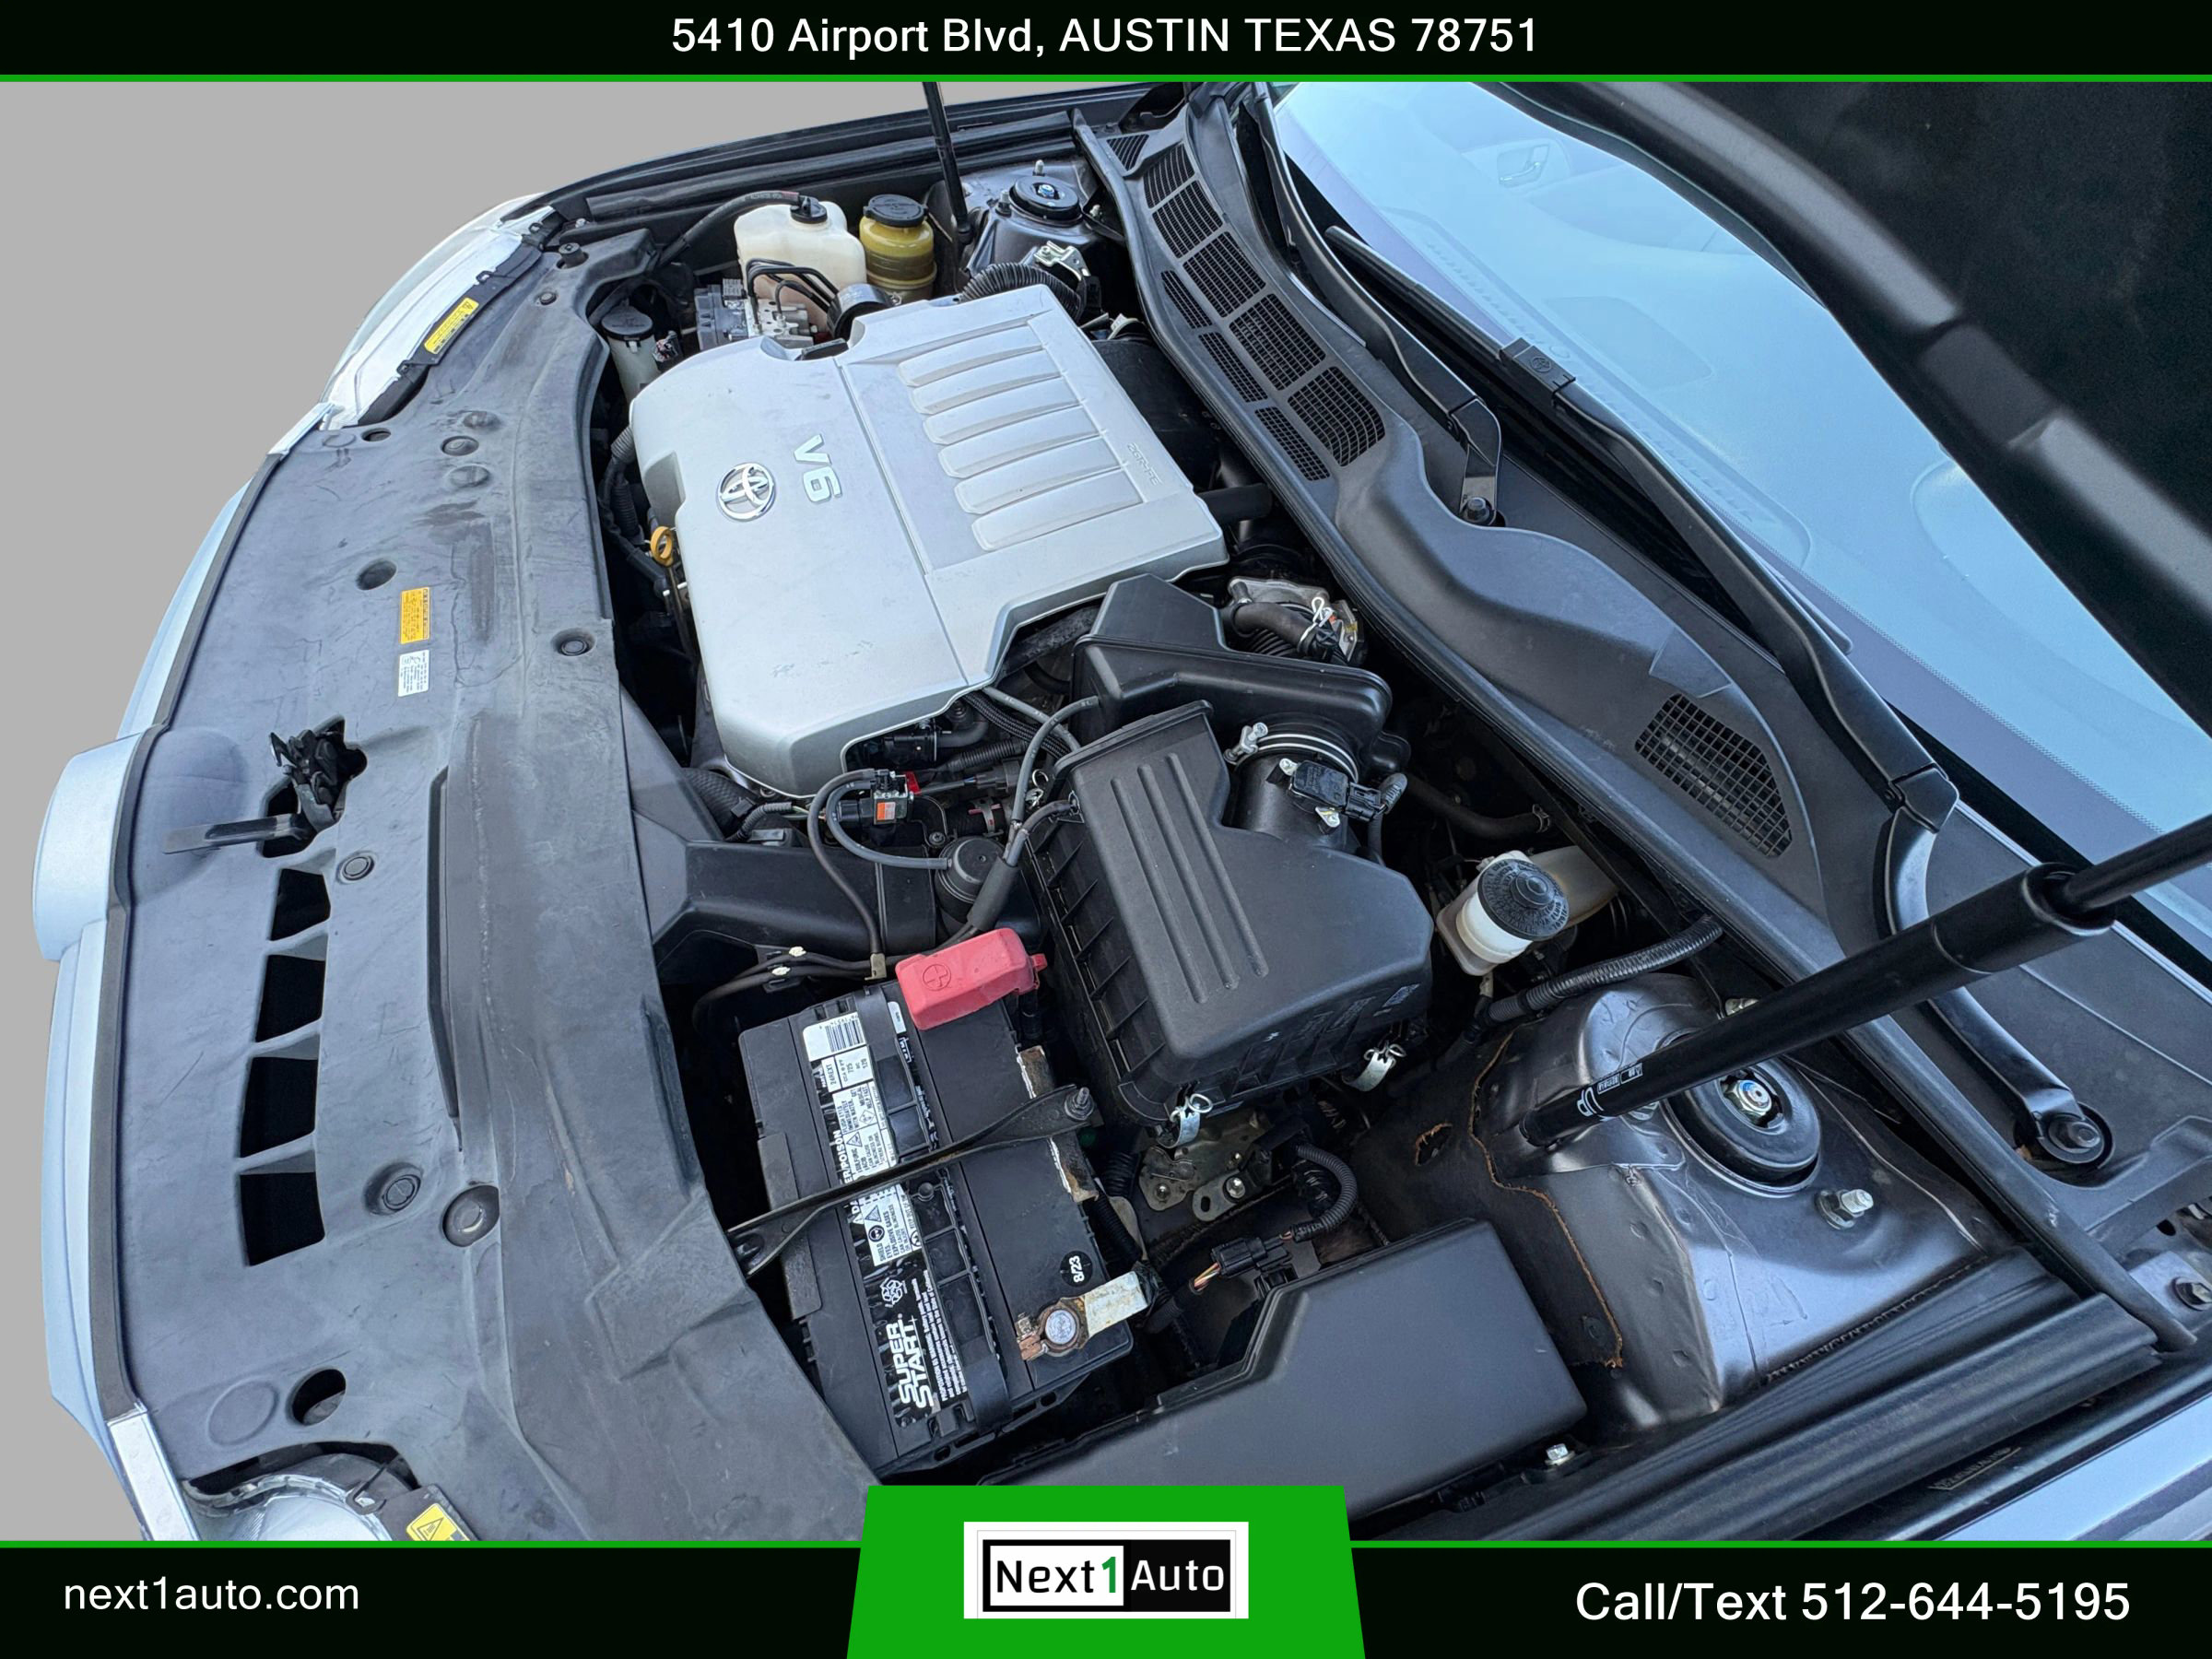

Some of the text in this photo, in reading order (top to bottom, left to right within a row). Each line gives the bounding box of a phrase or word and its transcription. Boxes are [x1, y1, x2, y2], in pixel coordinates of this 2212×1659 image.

[794, 434, 842, 504] V6
[1068, 1255, 1085, 1283] 8/23
[886, 1322, 917, 1404] SUPER
[899, 1320, 935, 1408] START
